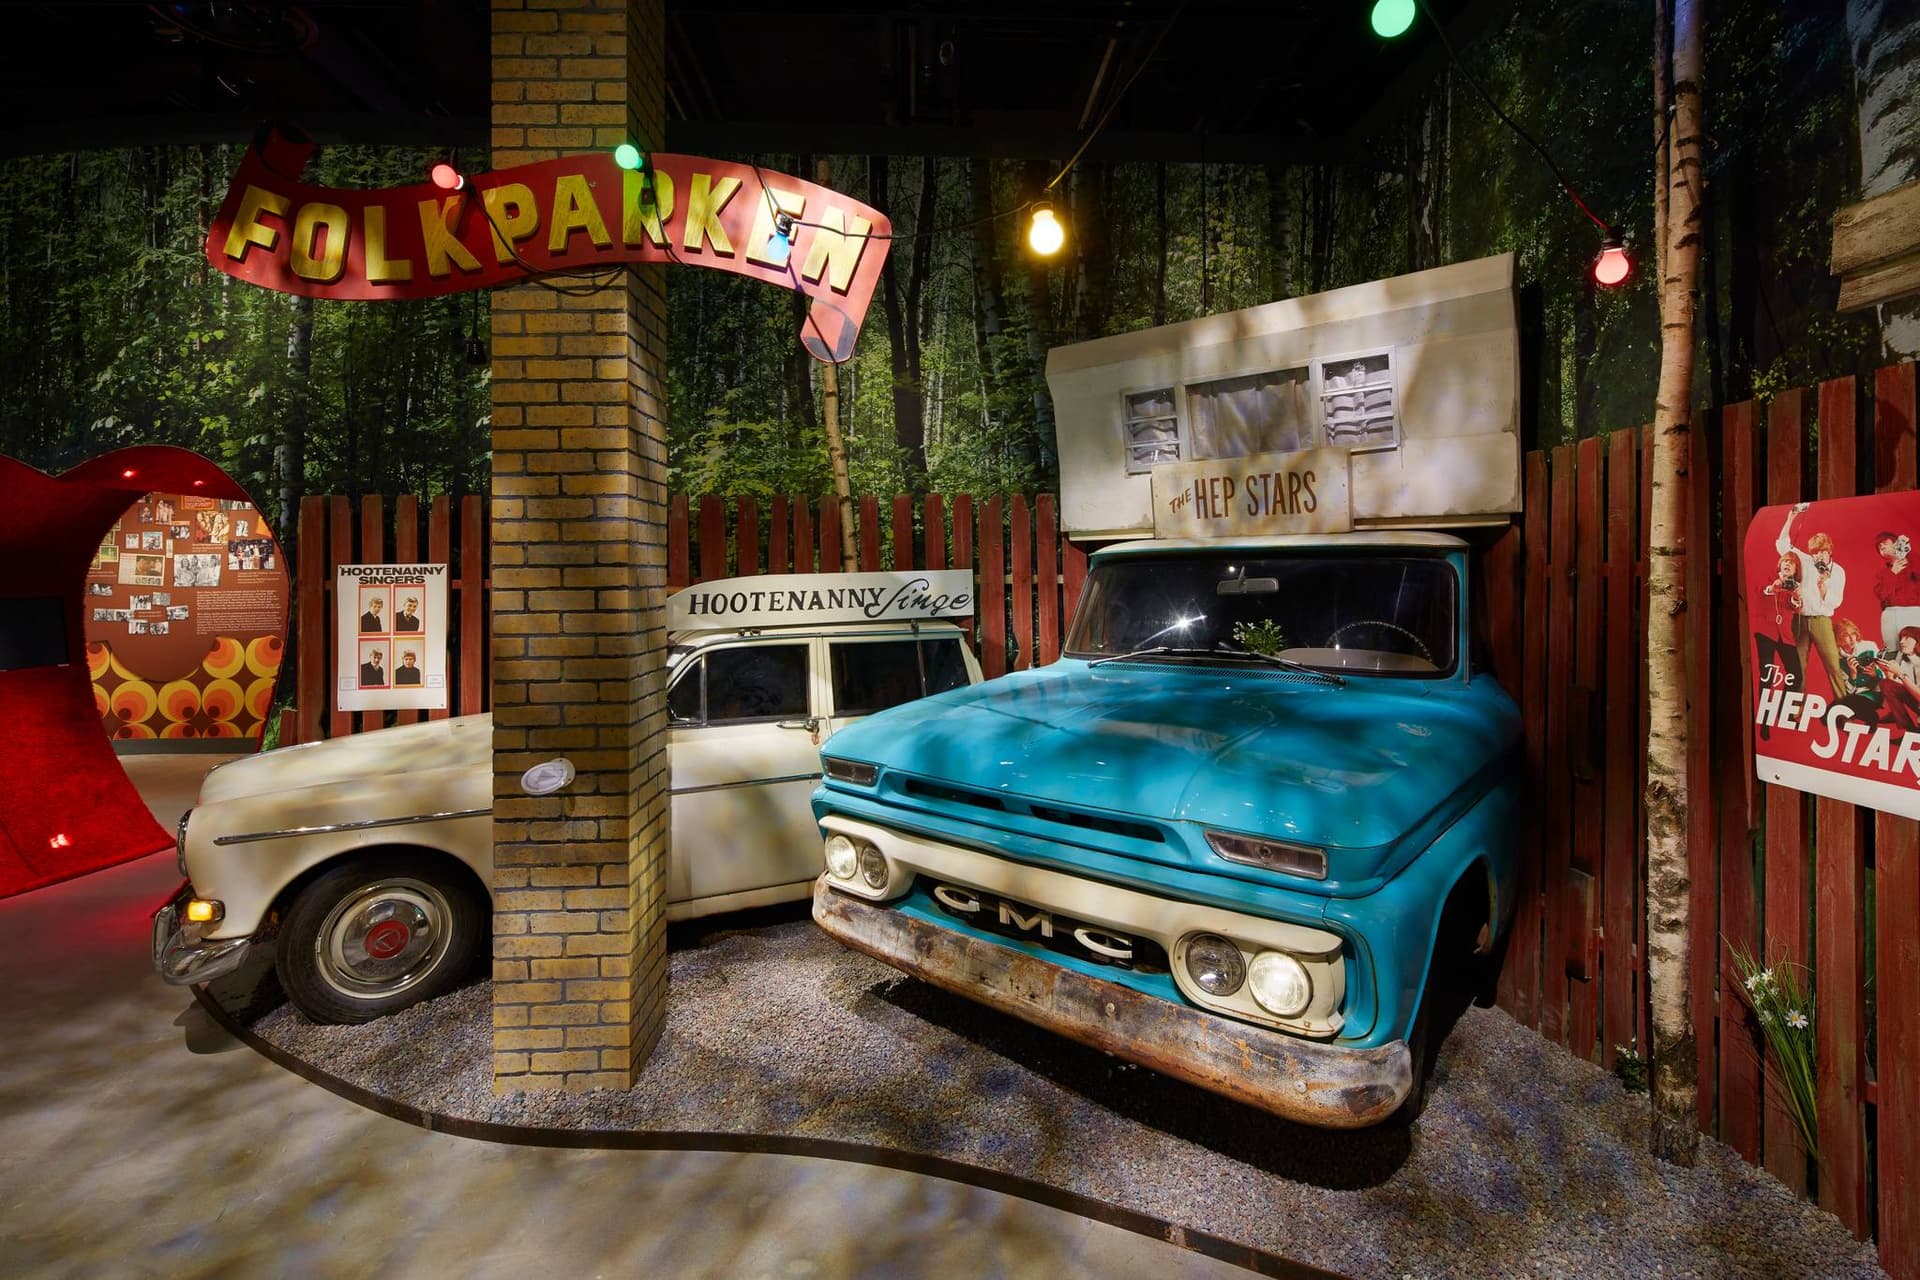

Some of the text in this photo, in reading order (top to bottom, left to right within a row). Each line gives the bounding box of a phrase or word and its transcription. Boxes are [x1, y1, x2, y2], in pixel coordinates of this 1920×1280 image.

[222, 171, 876, 295] FOLKPARKEN
[1169, 470, 1317, 520] THE HEP STARS
[340, 567, 444, 576] HOOTENANNY
[358, 575, 426, 585] SINGERS
[687, 587, 887, 616] HOOTENANNY
[1760, 663, 1795, 687] The
[1810, 704, 1920, 786] STAR
[933, 885, 1133, 959] GMC
